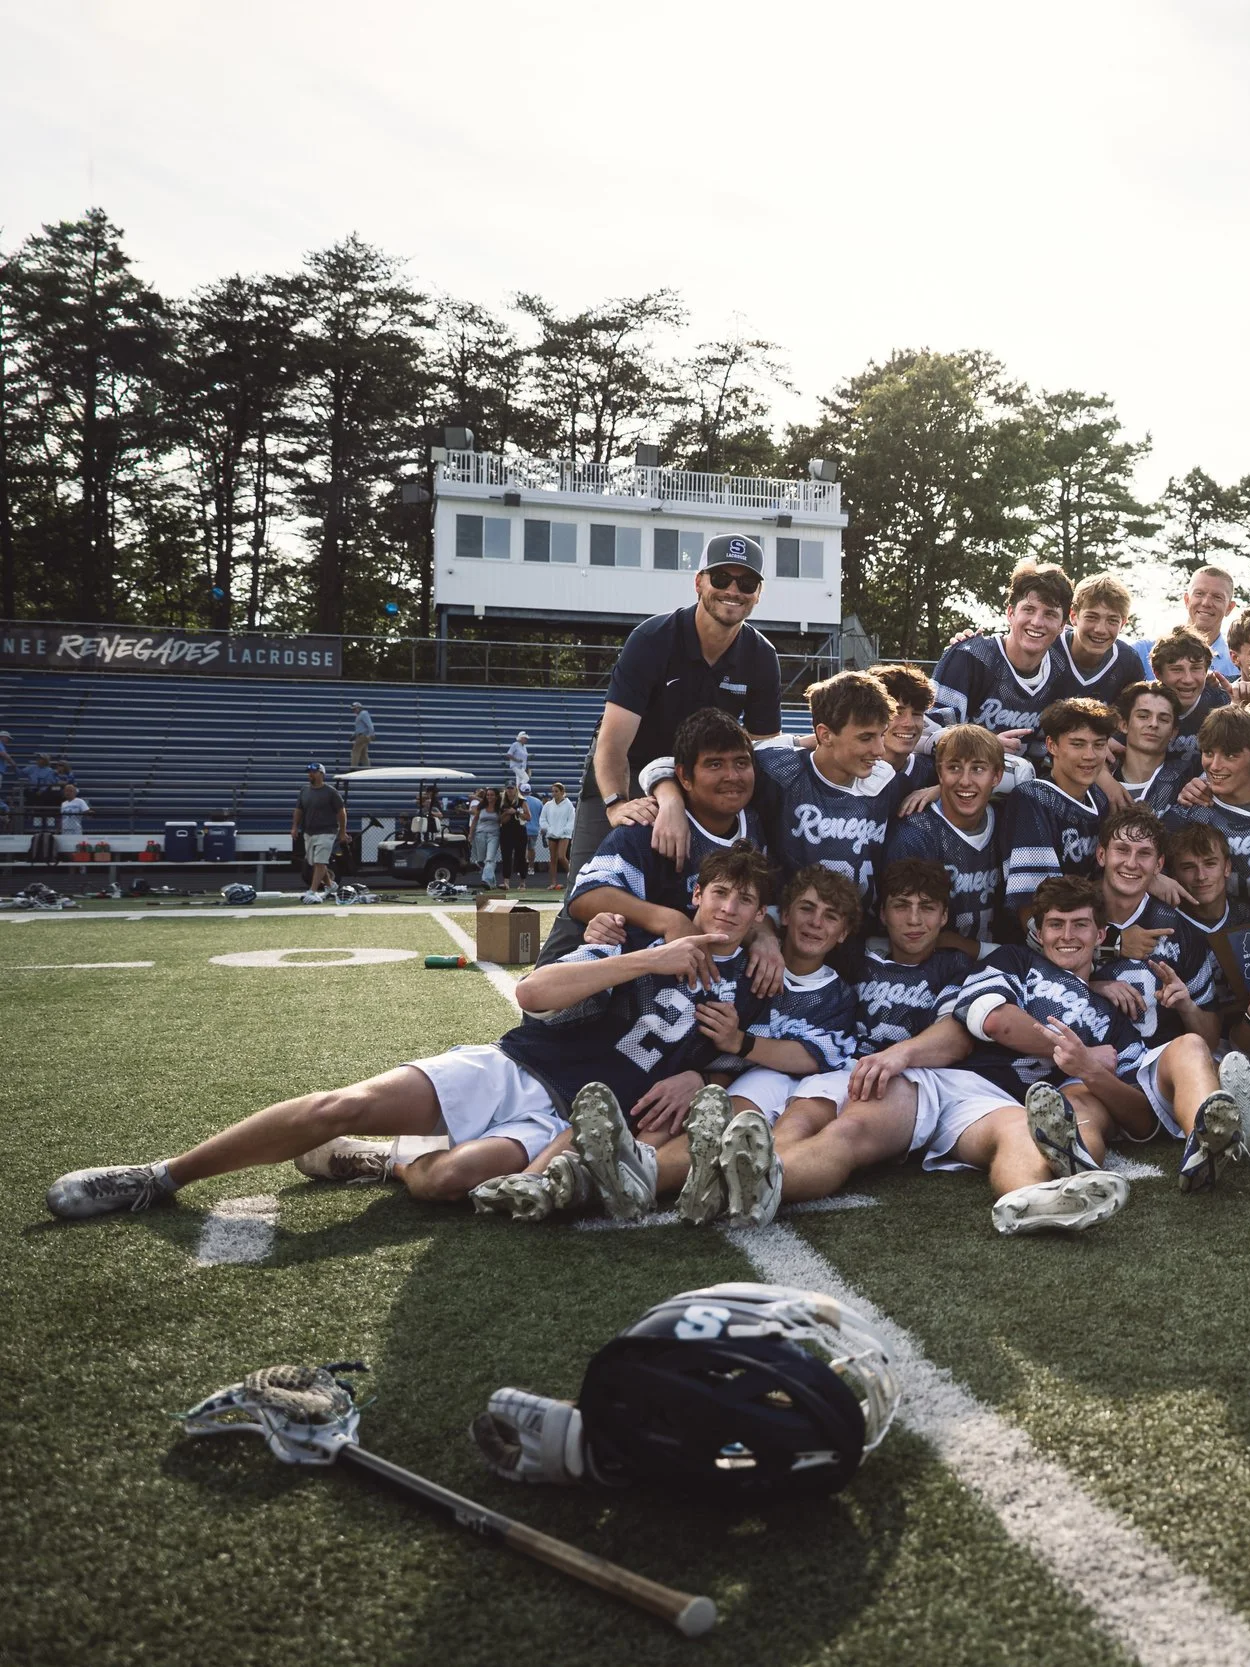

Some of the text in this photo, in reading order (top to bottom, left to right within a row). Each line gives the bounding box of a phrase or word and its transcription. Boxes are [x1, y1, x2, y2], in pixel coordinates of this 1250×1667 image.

[725, 552, 748, 561] LACROSSE
[730, 538, 747, 556] S
[2, 634, 334, 667] NEE RENEGADES LACROSSE
[674, 1304, 732, 1341] S
